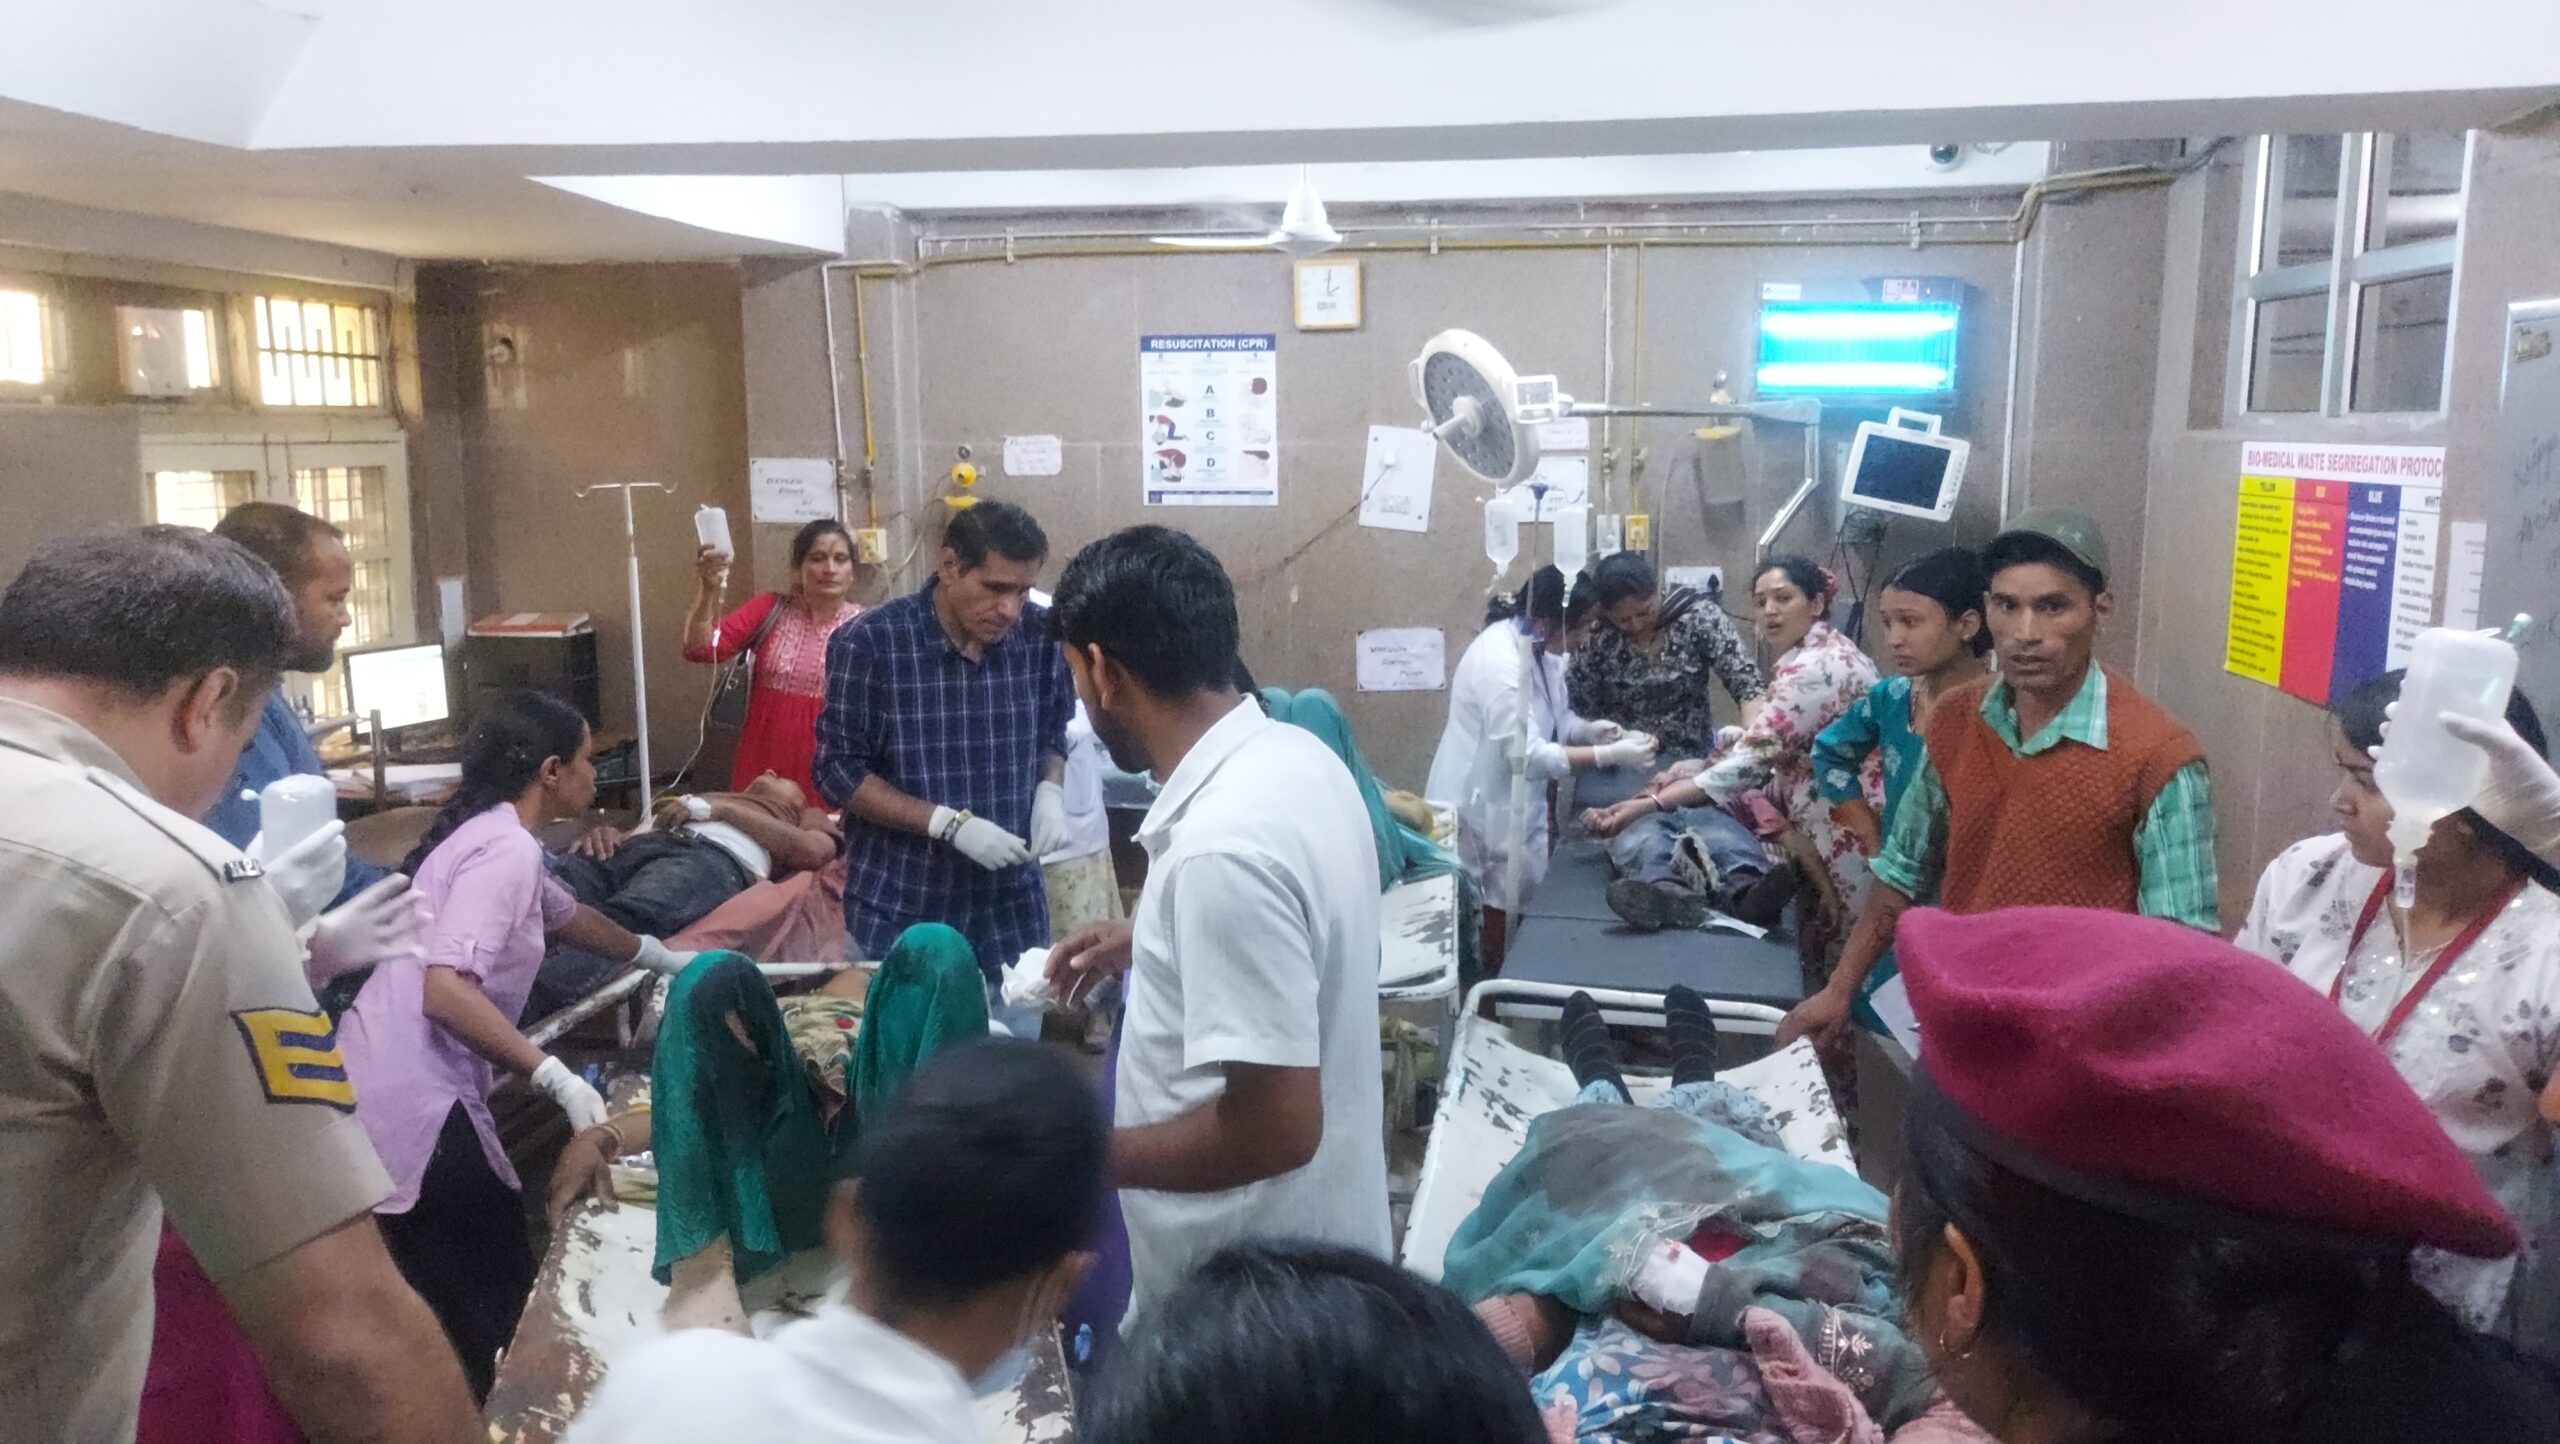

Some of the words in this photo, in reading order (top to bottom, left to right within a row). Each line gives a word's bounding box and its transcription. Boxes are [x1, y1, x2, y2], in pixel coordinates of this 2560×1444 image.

[1150, 339, 1236, 349] RESUSCITATION
[1238, 338, 1268, 350] (CPR)
[1205, 384, 1215, 395] A
[1206, 408, 1216, 419] B
[1206, 431, 1215, 441] C
[1206, 458, 1216, 468] D
[2247, 450, 2295, 469] BIO-MEDICAL
[2298, 452, 2325, 472] WASTE
[2327, 453, 2398, 476] SEGRREGATION
